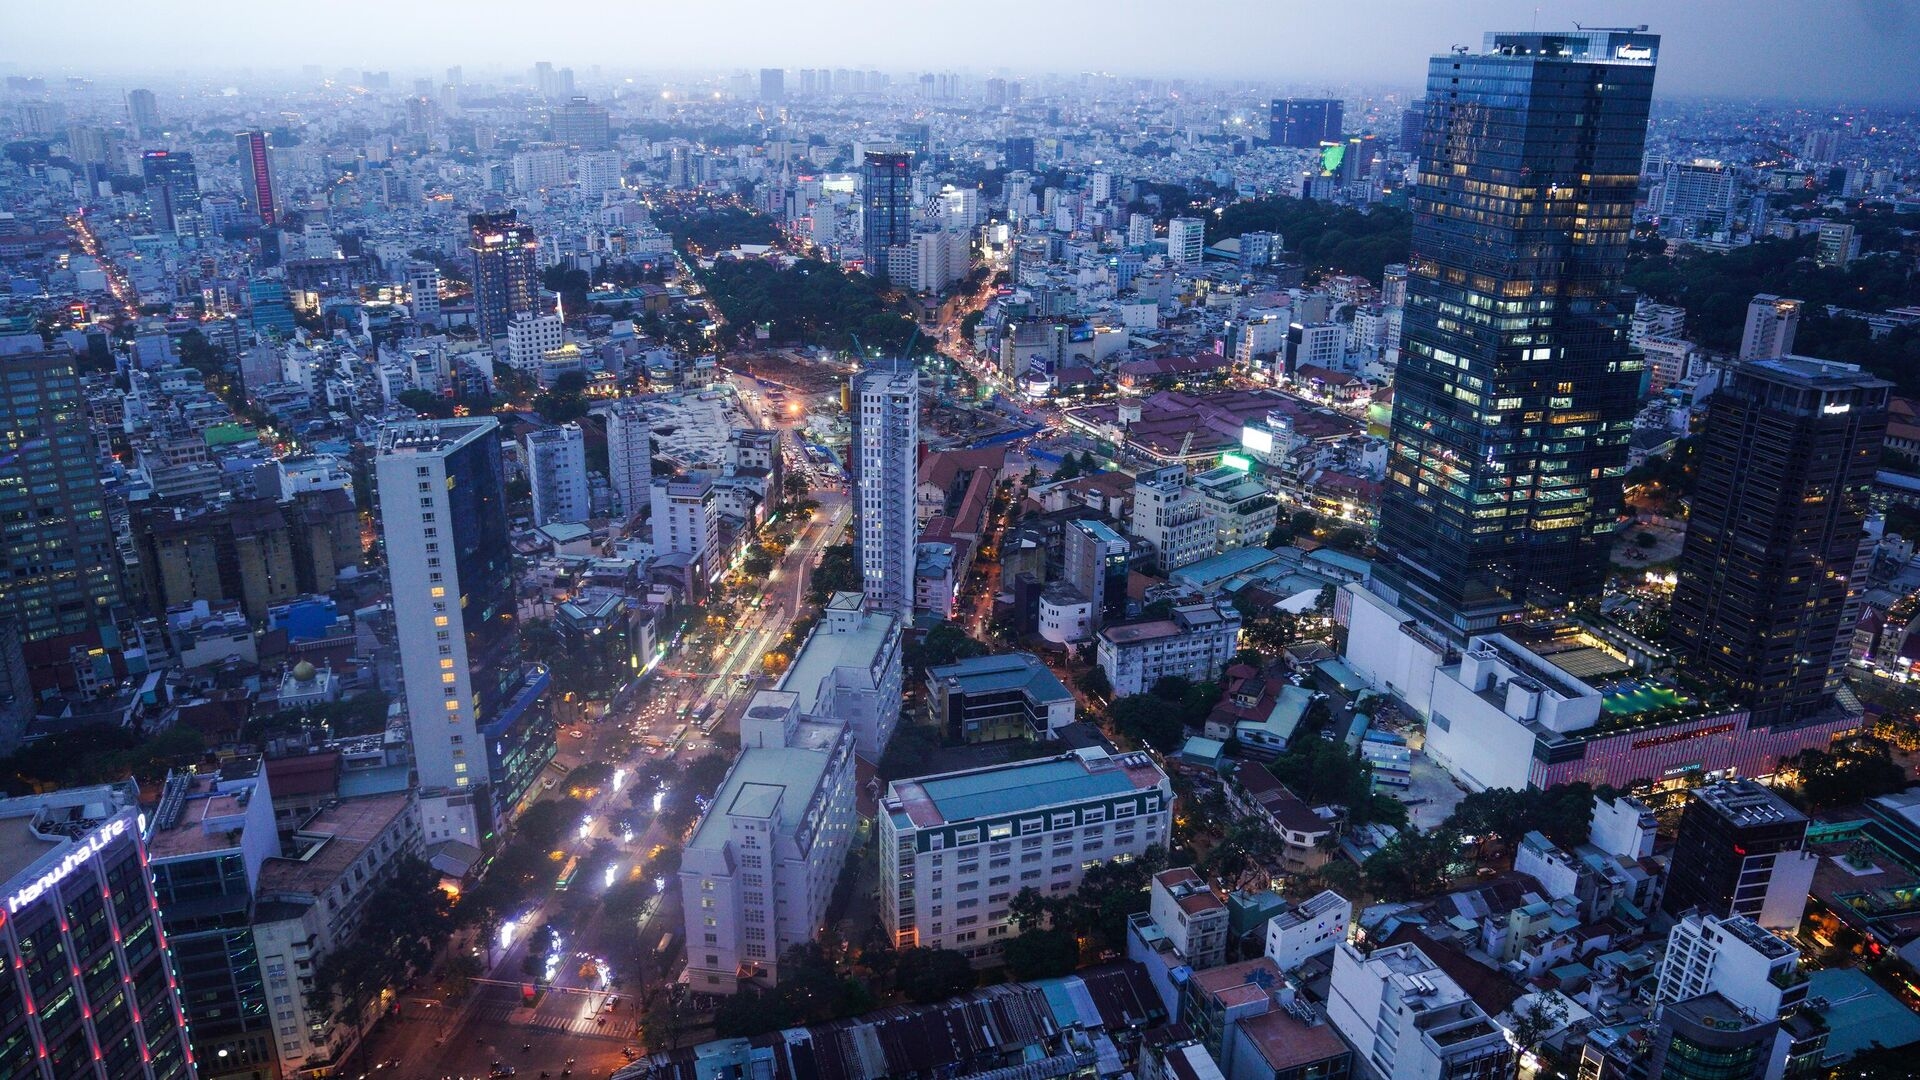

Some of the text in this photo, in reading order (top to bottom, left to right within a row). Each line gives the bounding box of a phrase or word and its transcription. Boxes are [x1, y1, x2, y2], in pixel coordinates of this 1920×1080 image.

[1031, 357, 1045, 370] CASIO
[9, 819, 124, 913] Hanwha Life
